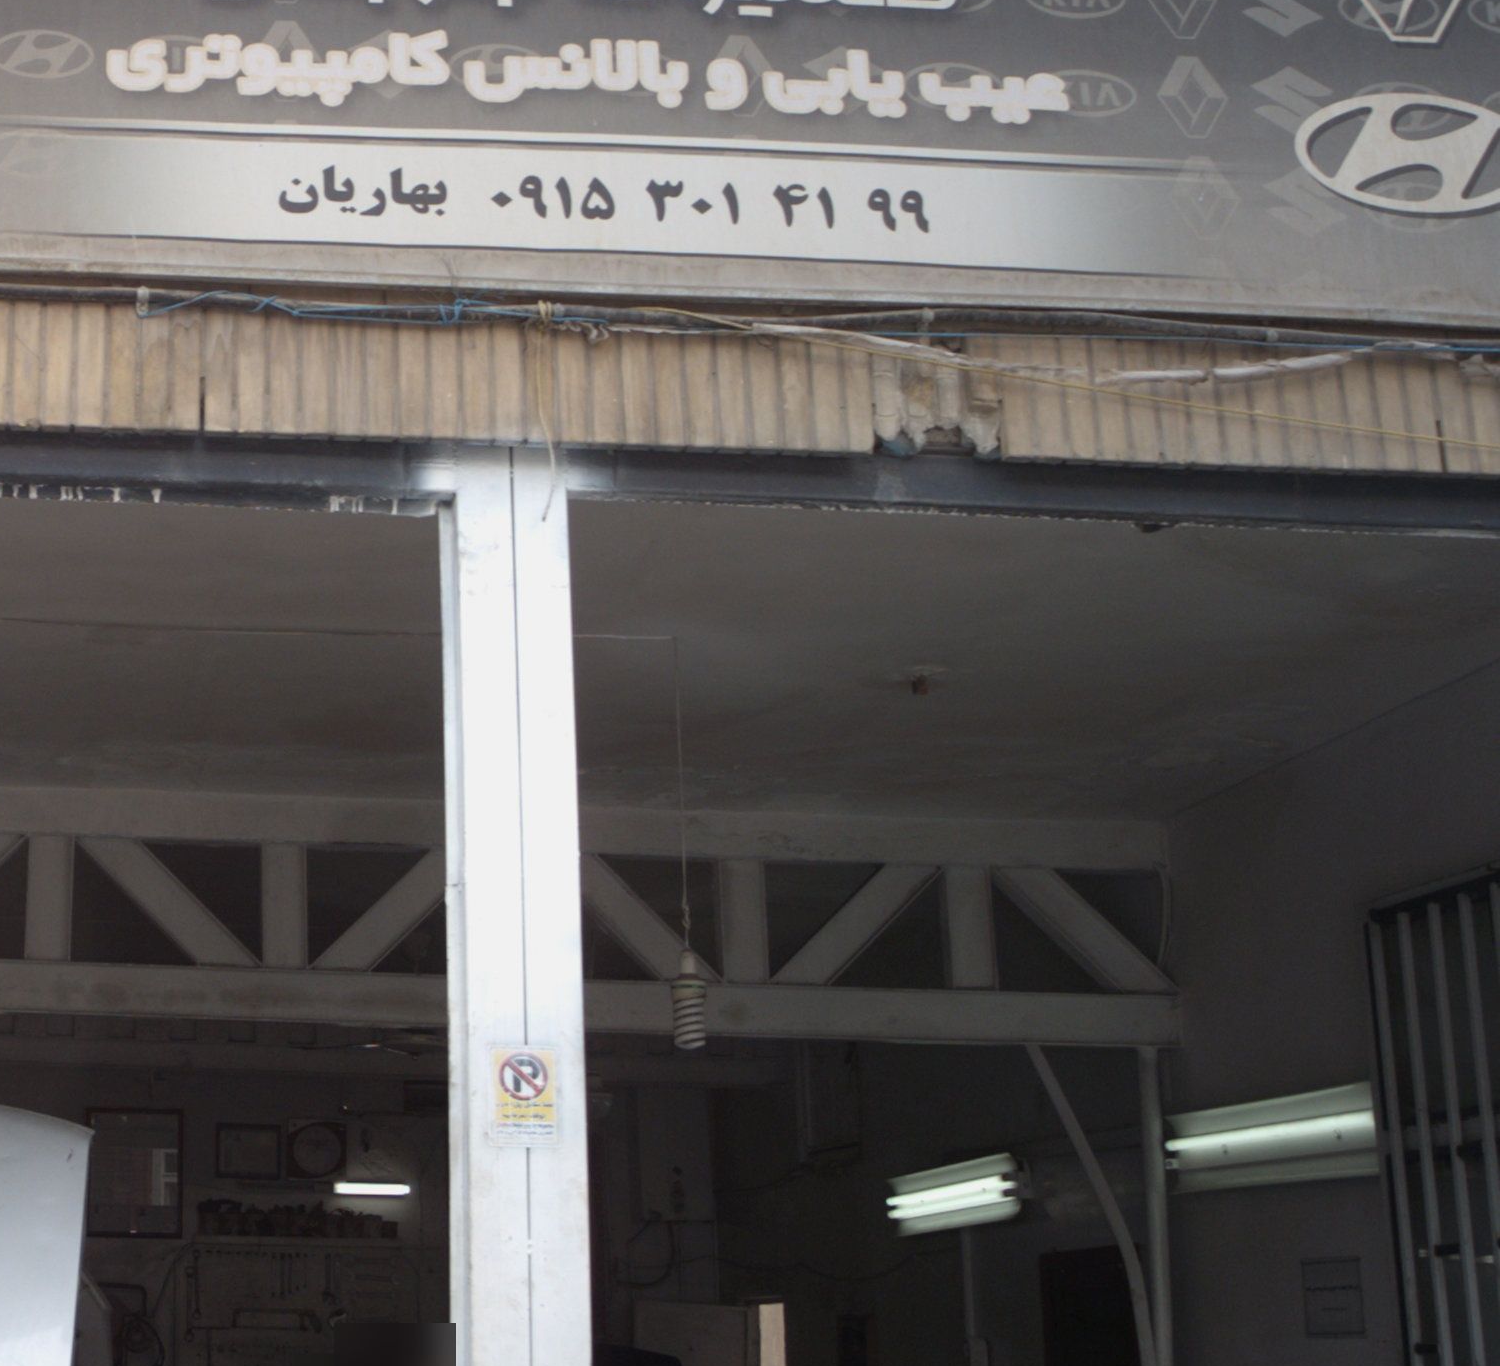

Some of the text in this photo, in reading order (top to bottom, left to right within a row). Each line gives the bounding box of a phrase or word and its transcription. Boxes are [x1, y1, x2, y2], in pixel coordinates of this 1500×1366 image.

[106, 30, 1071, 124] عیب یابی و بالانس کامپیوتری
[278, 164, 930, 234] ۰۹۱۵ ۳۰۱ ۴۱ ۹۹ بهاریان
